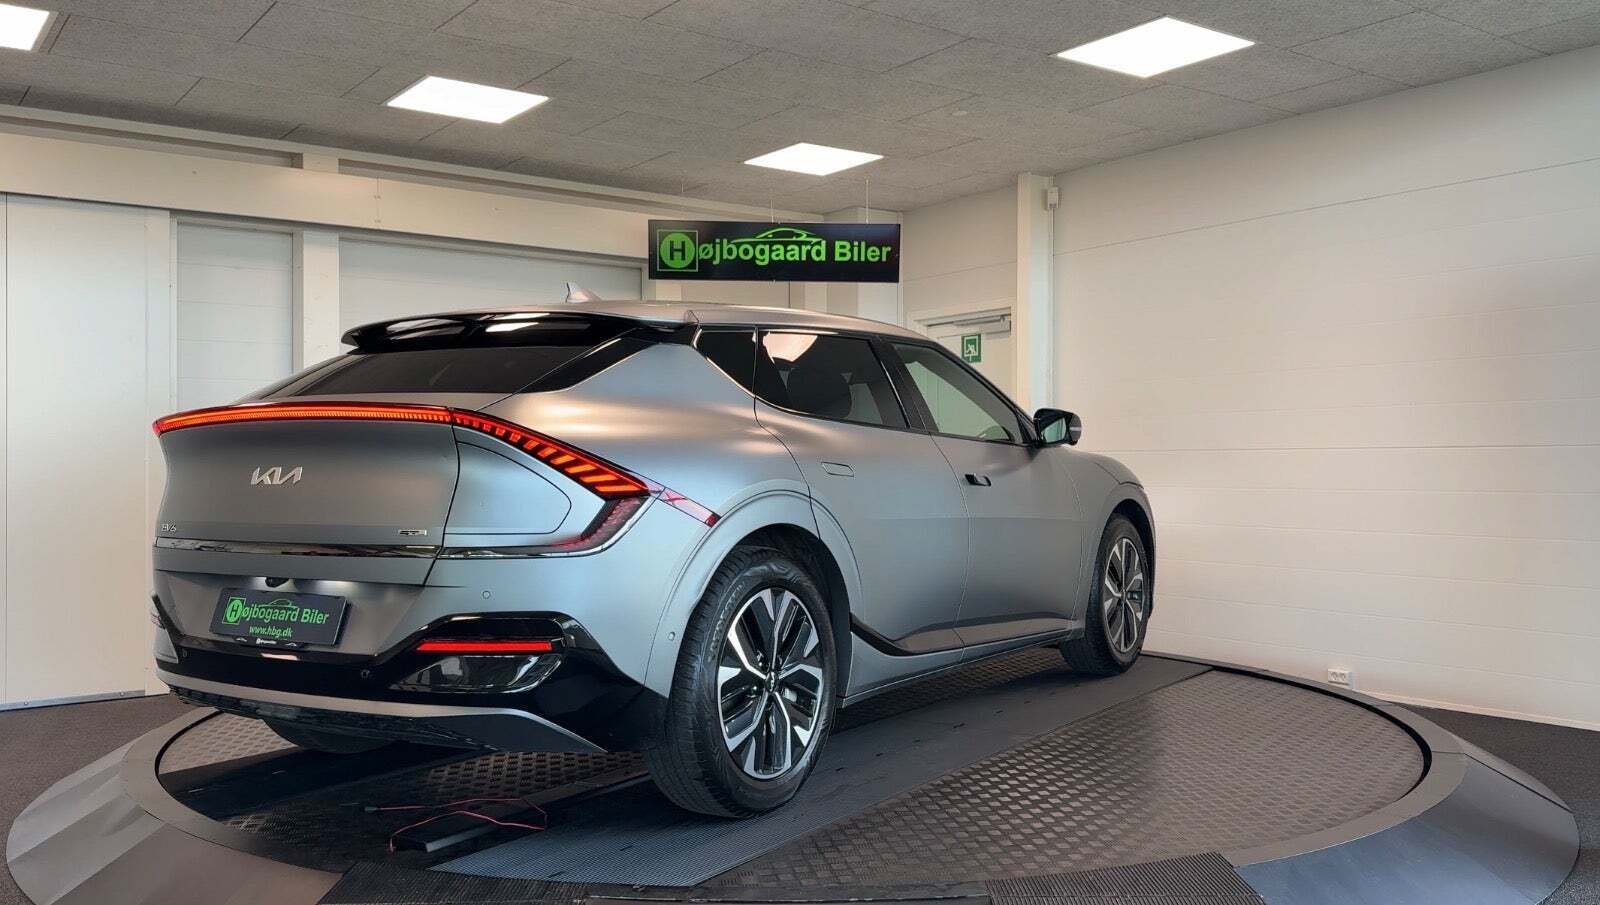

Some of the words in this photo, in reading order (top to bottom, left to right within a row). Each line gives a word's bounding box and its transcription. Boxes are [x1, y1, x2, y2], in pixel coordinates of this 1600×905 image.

[660, 233, 826, 268] Højbogaard
[834, 240, 891, 262] Biler
[250, 466, 303, 485] KIA
[226, 600, 300, 623] Højbogaard
[301, 608, 330, 625] Biler
[249, 625, 294, 639] www.hbg.dk
